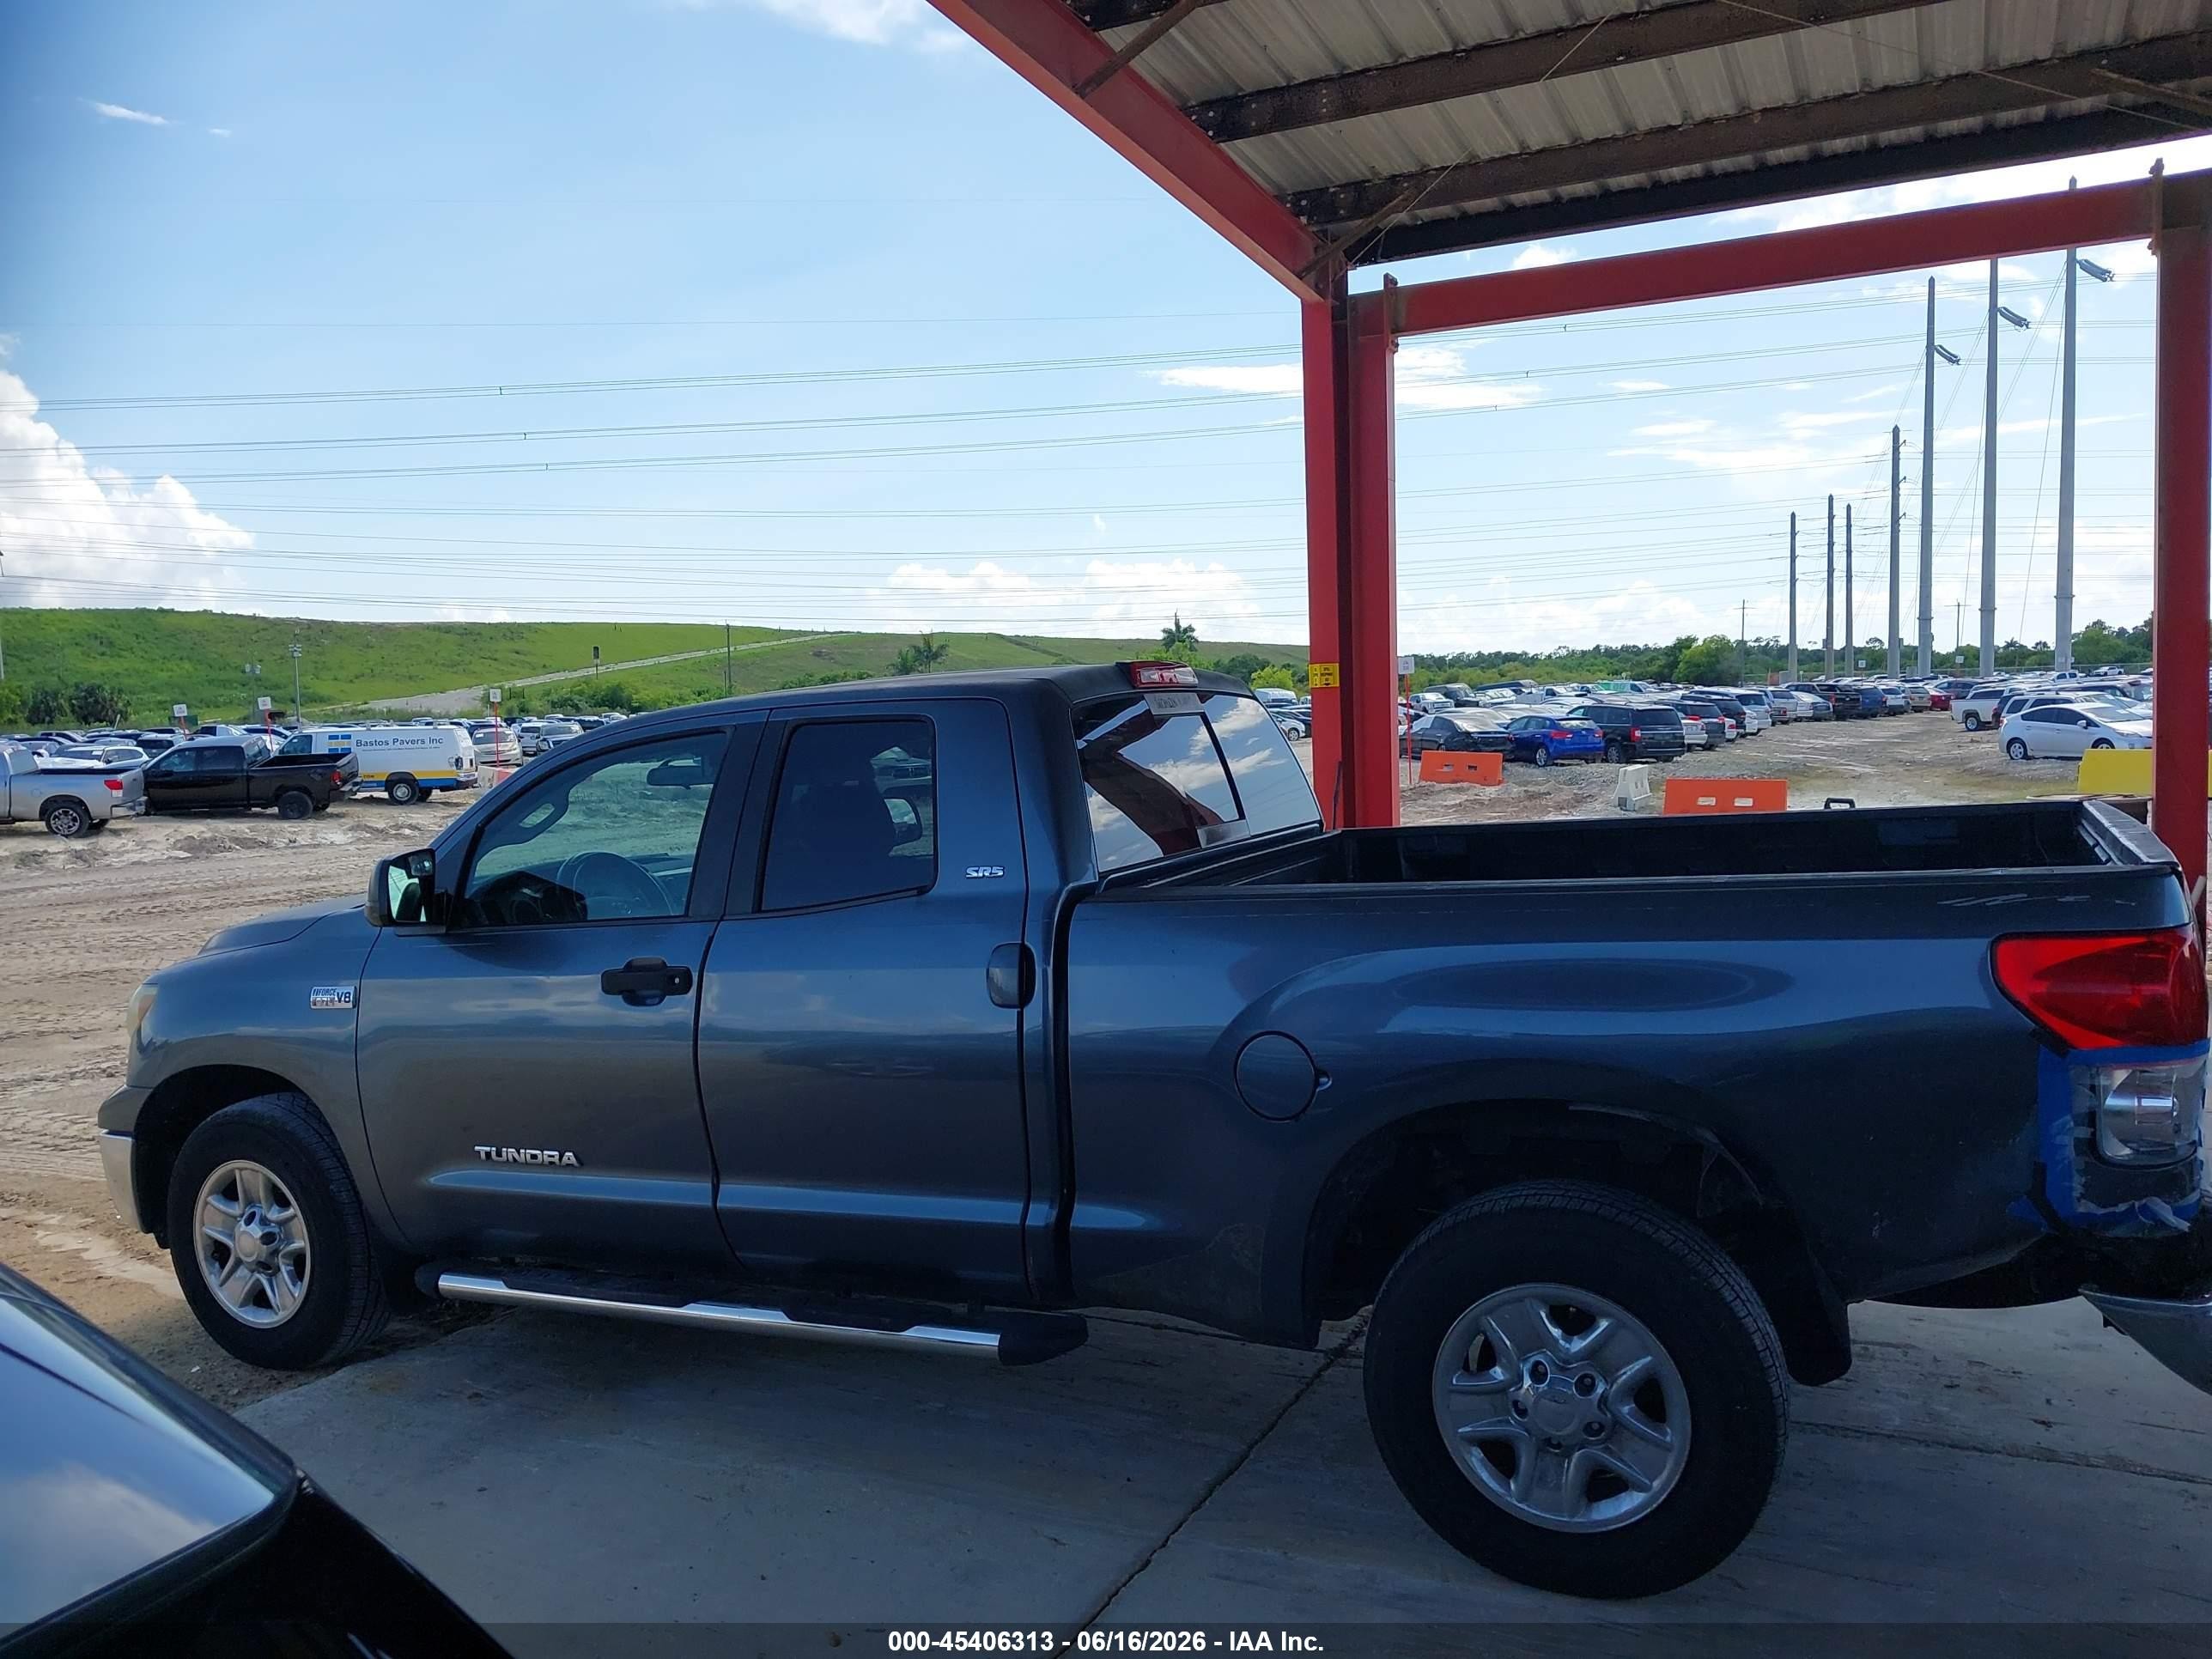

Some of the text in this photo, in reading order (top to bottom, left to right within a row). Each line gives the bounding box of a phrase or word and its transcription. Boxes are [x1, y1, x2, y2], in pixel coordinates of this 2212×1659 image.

[356, 738, 390, 747] Bastos
[428, 736, 443, 744] Inc
[965, 867, 1004, 878] SR5
[336, 991, 351, 1004] V8
[474, 1146, 580, 1167] TUNDRA
